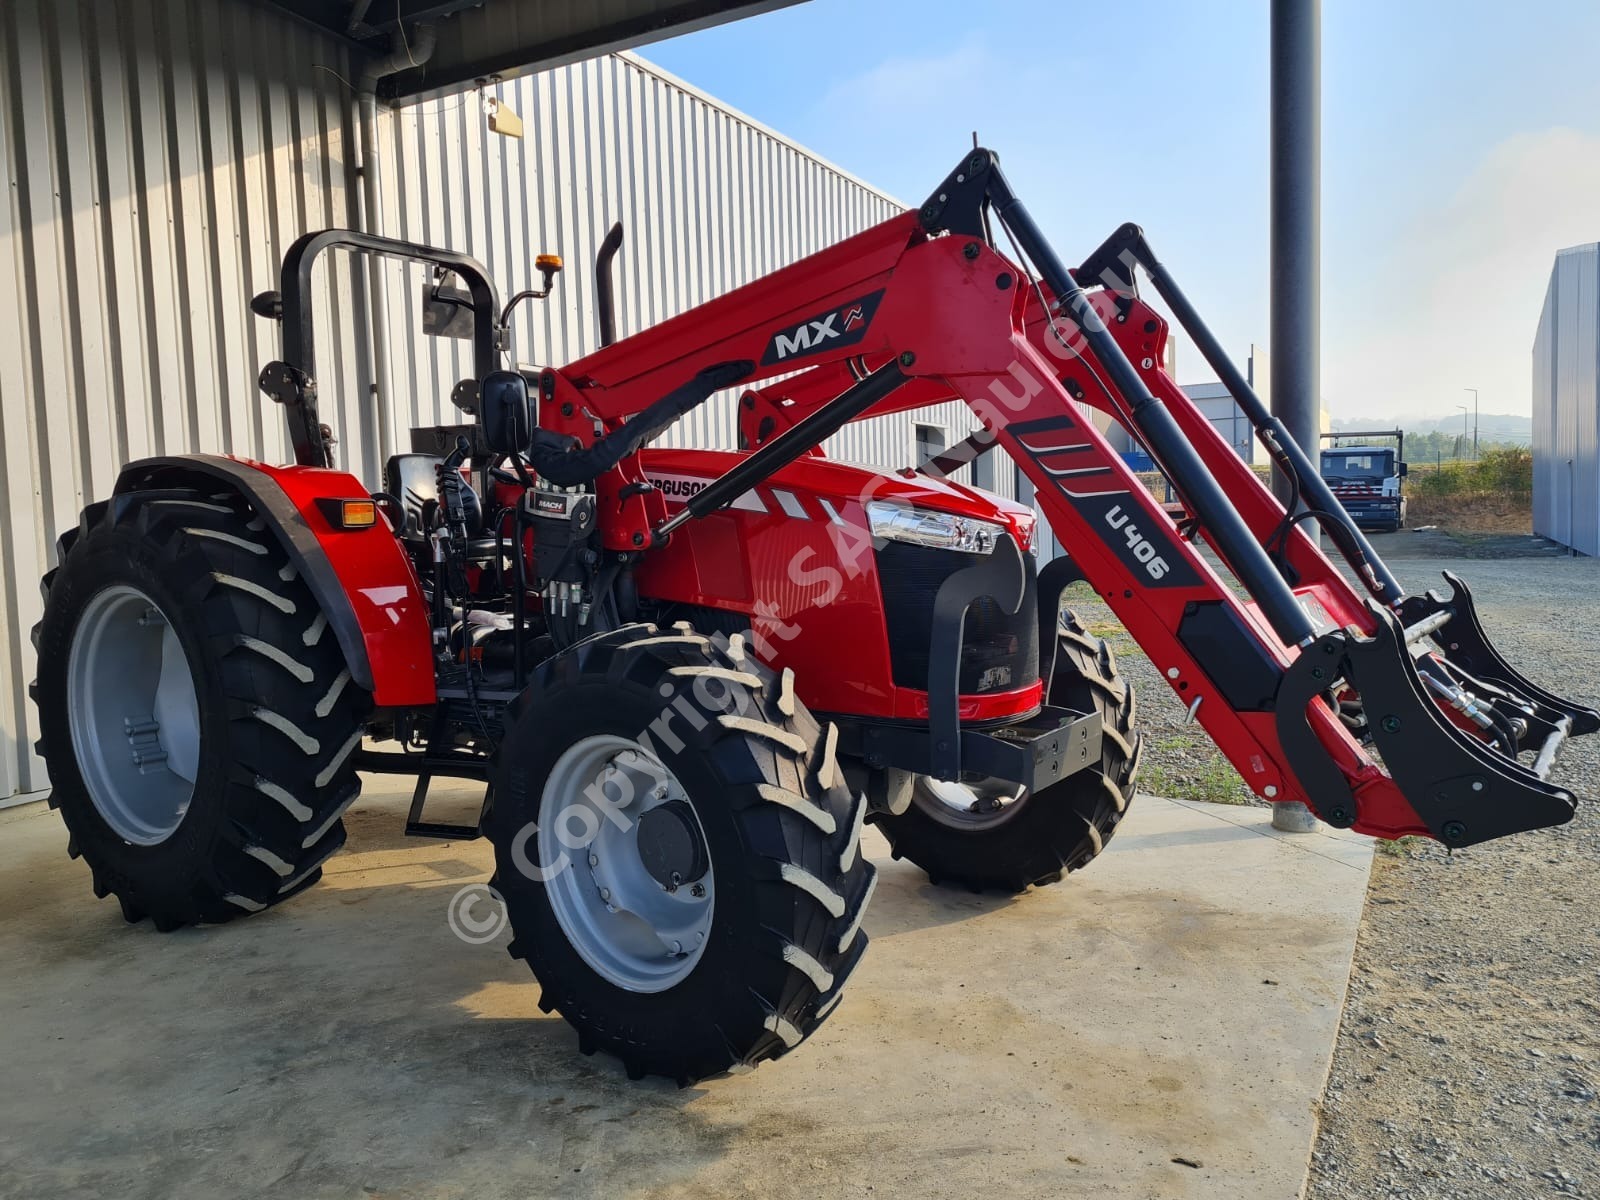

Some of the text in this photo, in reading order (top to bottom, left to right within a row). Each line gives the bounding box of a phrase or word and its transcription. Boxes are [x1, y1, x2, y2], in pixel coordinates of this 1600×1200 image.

[775, 312, 840, 359] MX
[648, 479, 707, 496] RGUSO
[538, 500, 563, 509] MACH
